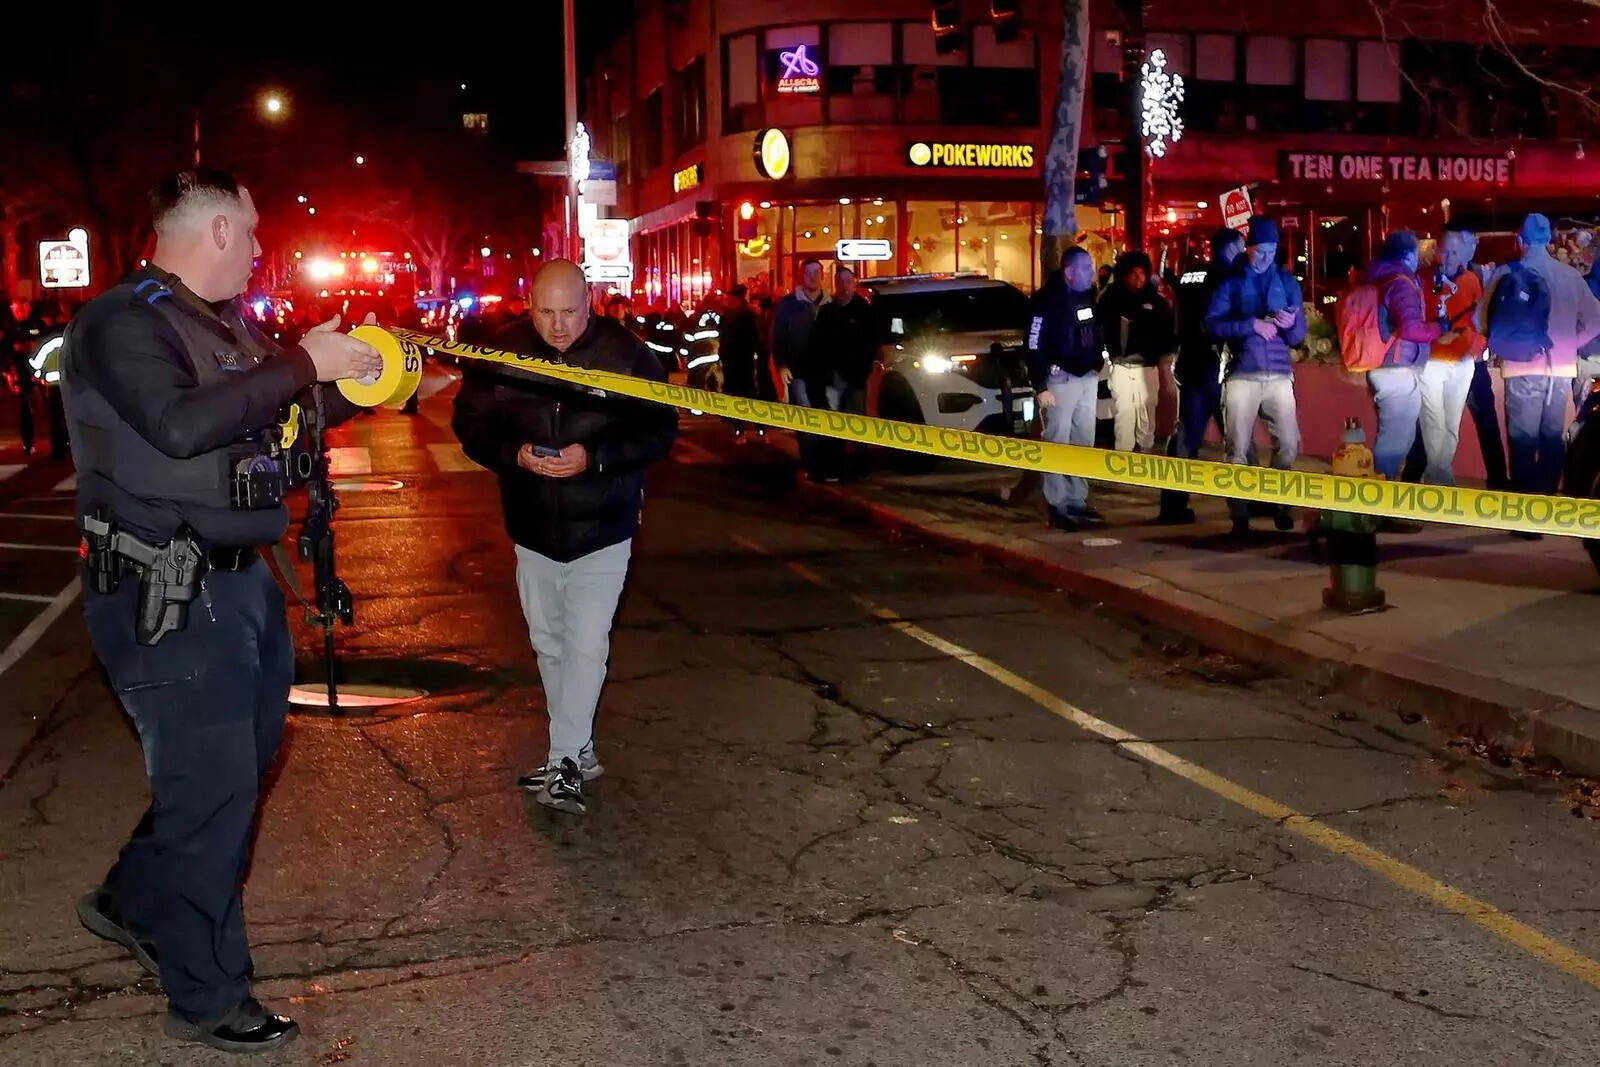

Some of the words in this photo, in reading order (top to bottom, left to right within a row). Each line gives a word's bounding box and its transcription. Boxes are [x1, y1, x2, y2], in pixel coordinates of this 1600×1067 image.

[932, 143, 1033, 167] POKEWORKS
[1289, 154, 1333, 179] TEN
[1340, 155, 1383, 179] ONE
[1388, 157, 1432, 181] TEA
[1438, 157, 1509, 182] HOUSE
[1226, 204, 1235, 214] DO
